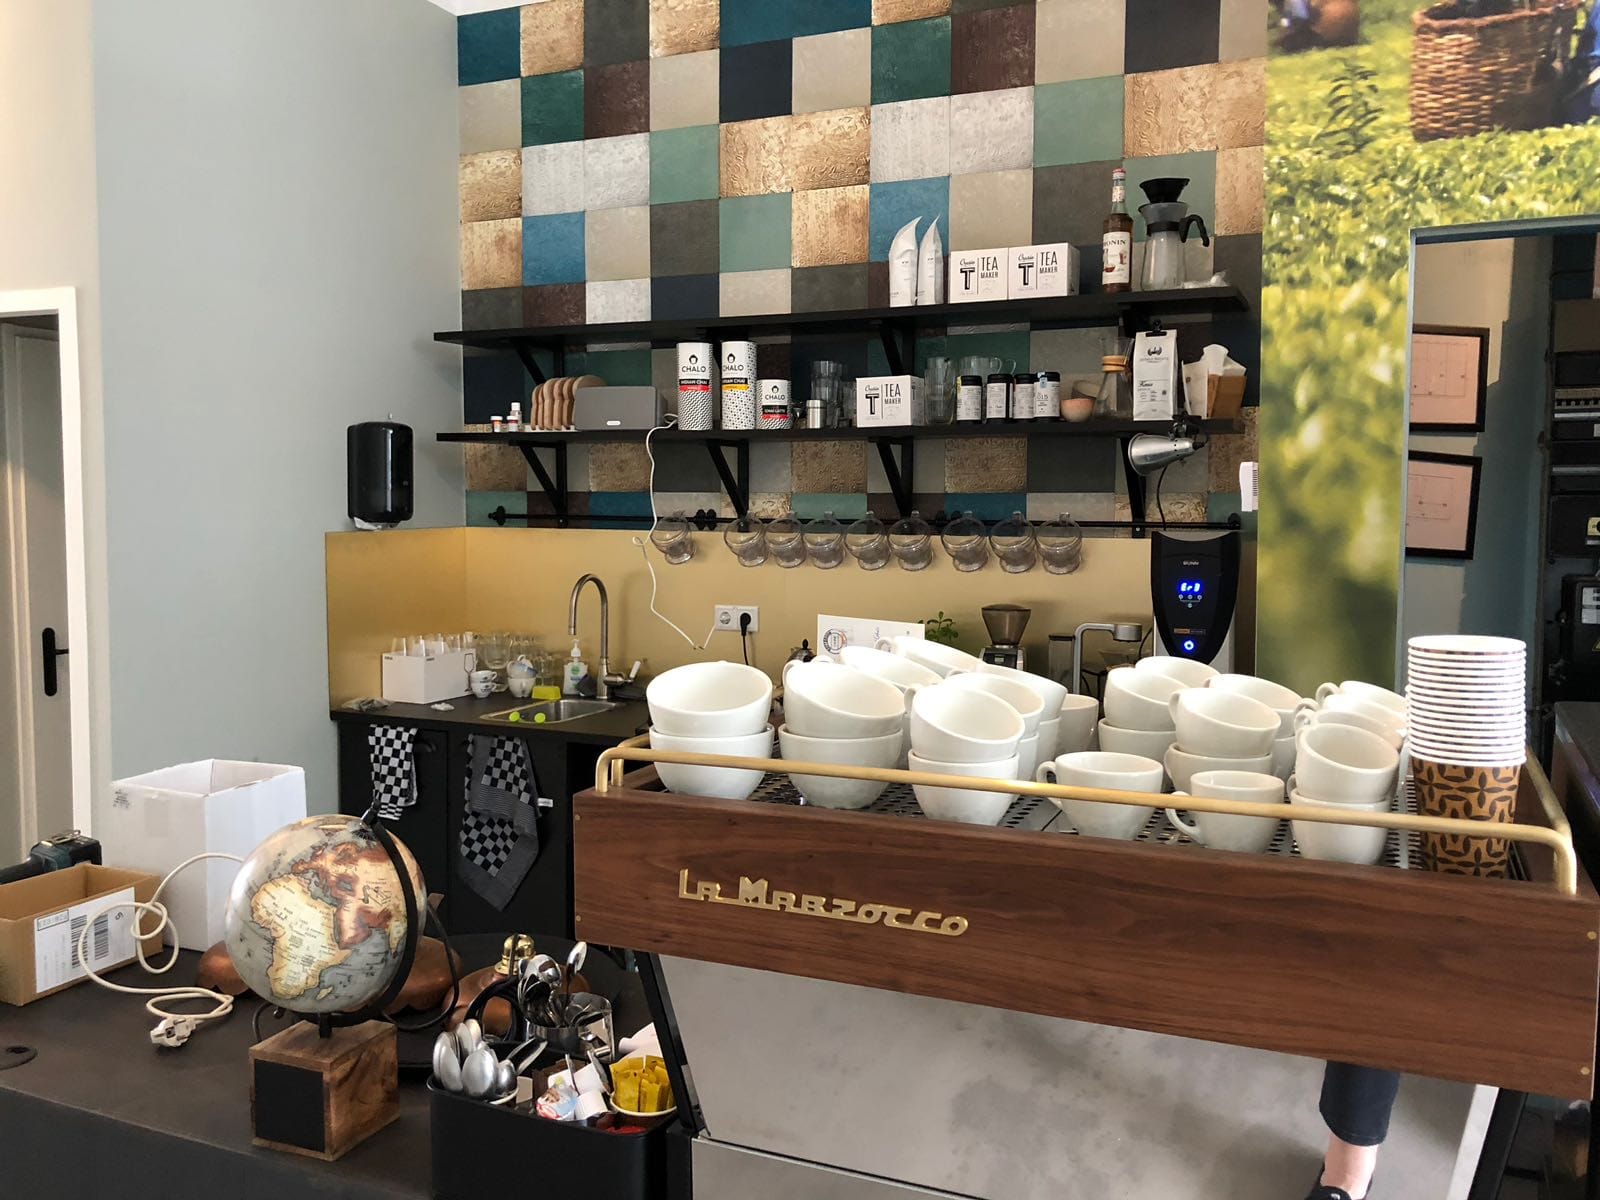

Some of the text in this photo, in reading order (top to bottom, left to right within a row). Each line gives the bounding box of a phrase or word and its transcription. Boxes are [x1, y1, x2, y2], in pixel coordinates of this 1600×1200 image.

[981, 256, 999, 272] TEA
[1040, 251, 1058, 266] TEA
[980, 271, 999, 279] MAKER
[1018, 262, 1035, 286] T
[1039, 266, 1058, 274] MAKER
[960, 267, 976, 290] T
[681, 365, 707, 373] CHALO
[722, 364, 745, 372] CHALO
[884, 383, 901, 398] TEA
[865, 393, 880, 415] T
